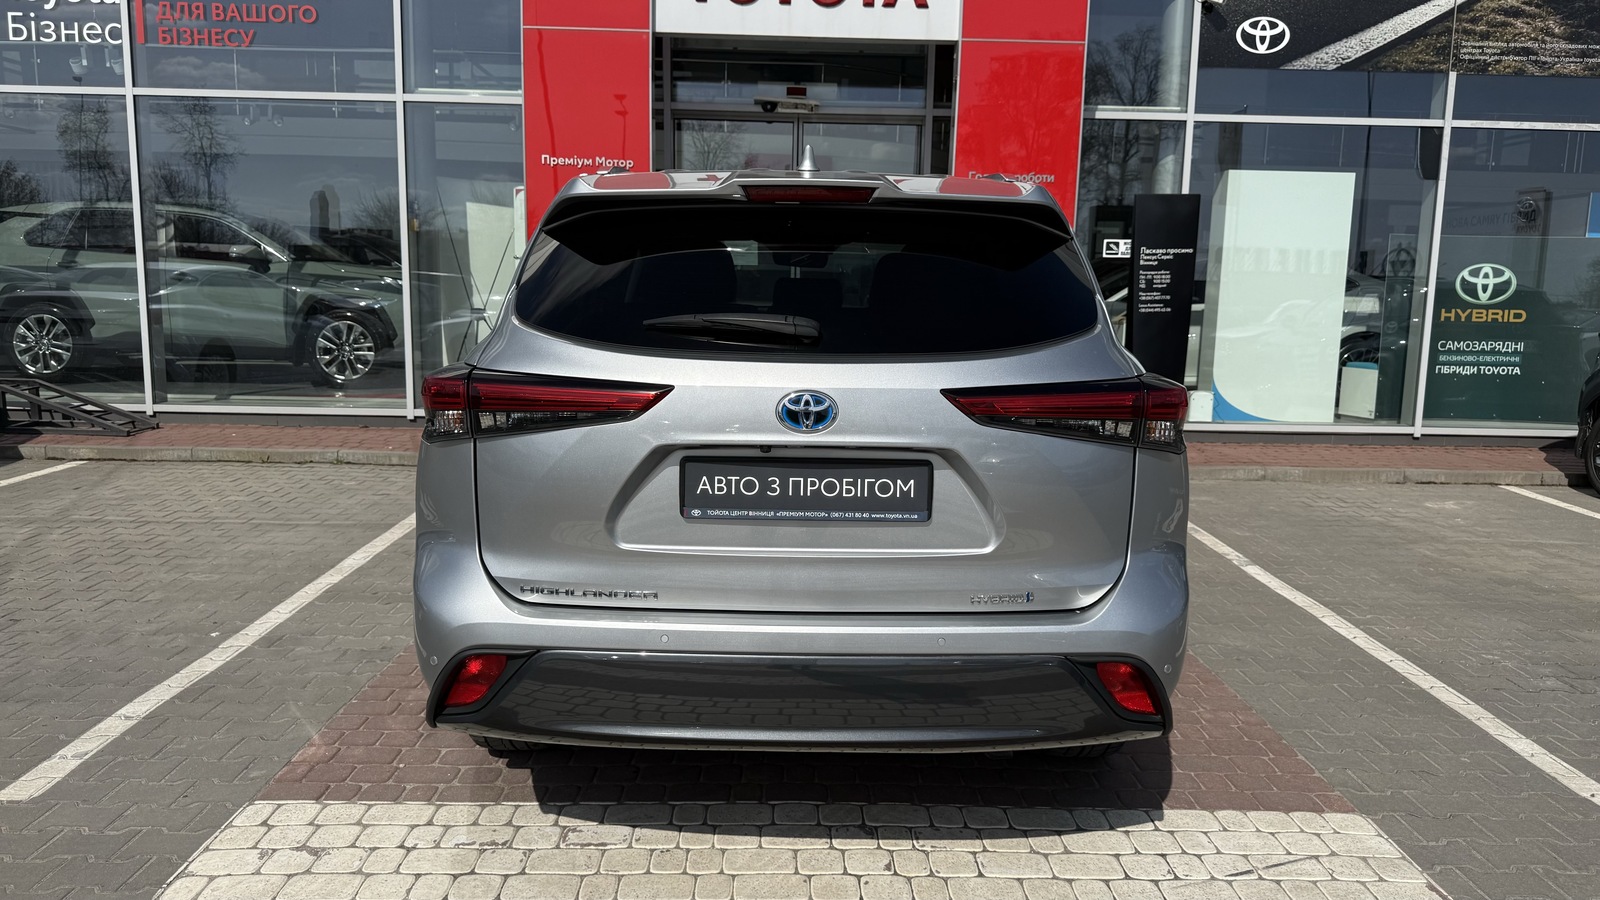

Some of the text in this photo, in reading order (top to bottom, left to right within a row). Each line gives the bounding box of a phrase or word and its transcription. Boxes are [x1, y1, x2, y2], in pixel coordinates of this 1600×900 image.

[156, 1, 318, 24] ДЛЯ ВАШОГО
[7, 12, 123, 44] Бізнес
[158, 27, 255, 48] БІЗНЕСУ
[541, 154, 634, 170] Преміум Мотор
[1440, 308, 1527, 322] HYBRID
[1437, 341, 1524, 353] САМОЗАРЯДНІ
[1435, 366, 1521, 375] ГІБРИДИ TOYOTA
[697, 476, 915, 498] АВТО З ПРОБІГОМ
[520, 586, 659, 601] HIGHLANDER
